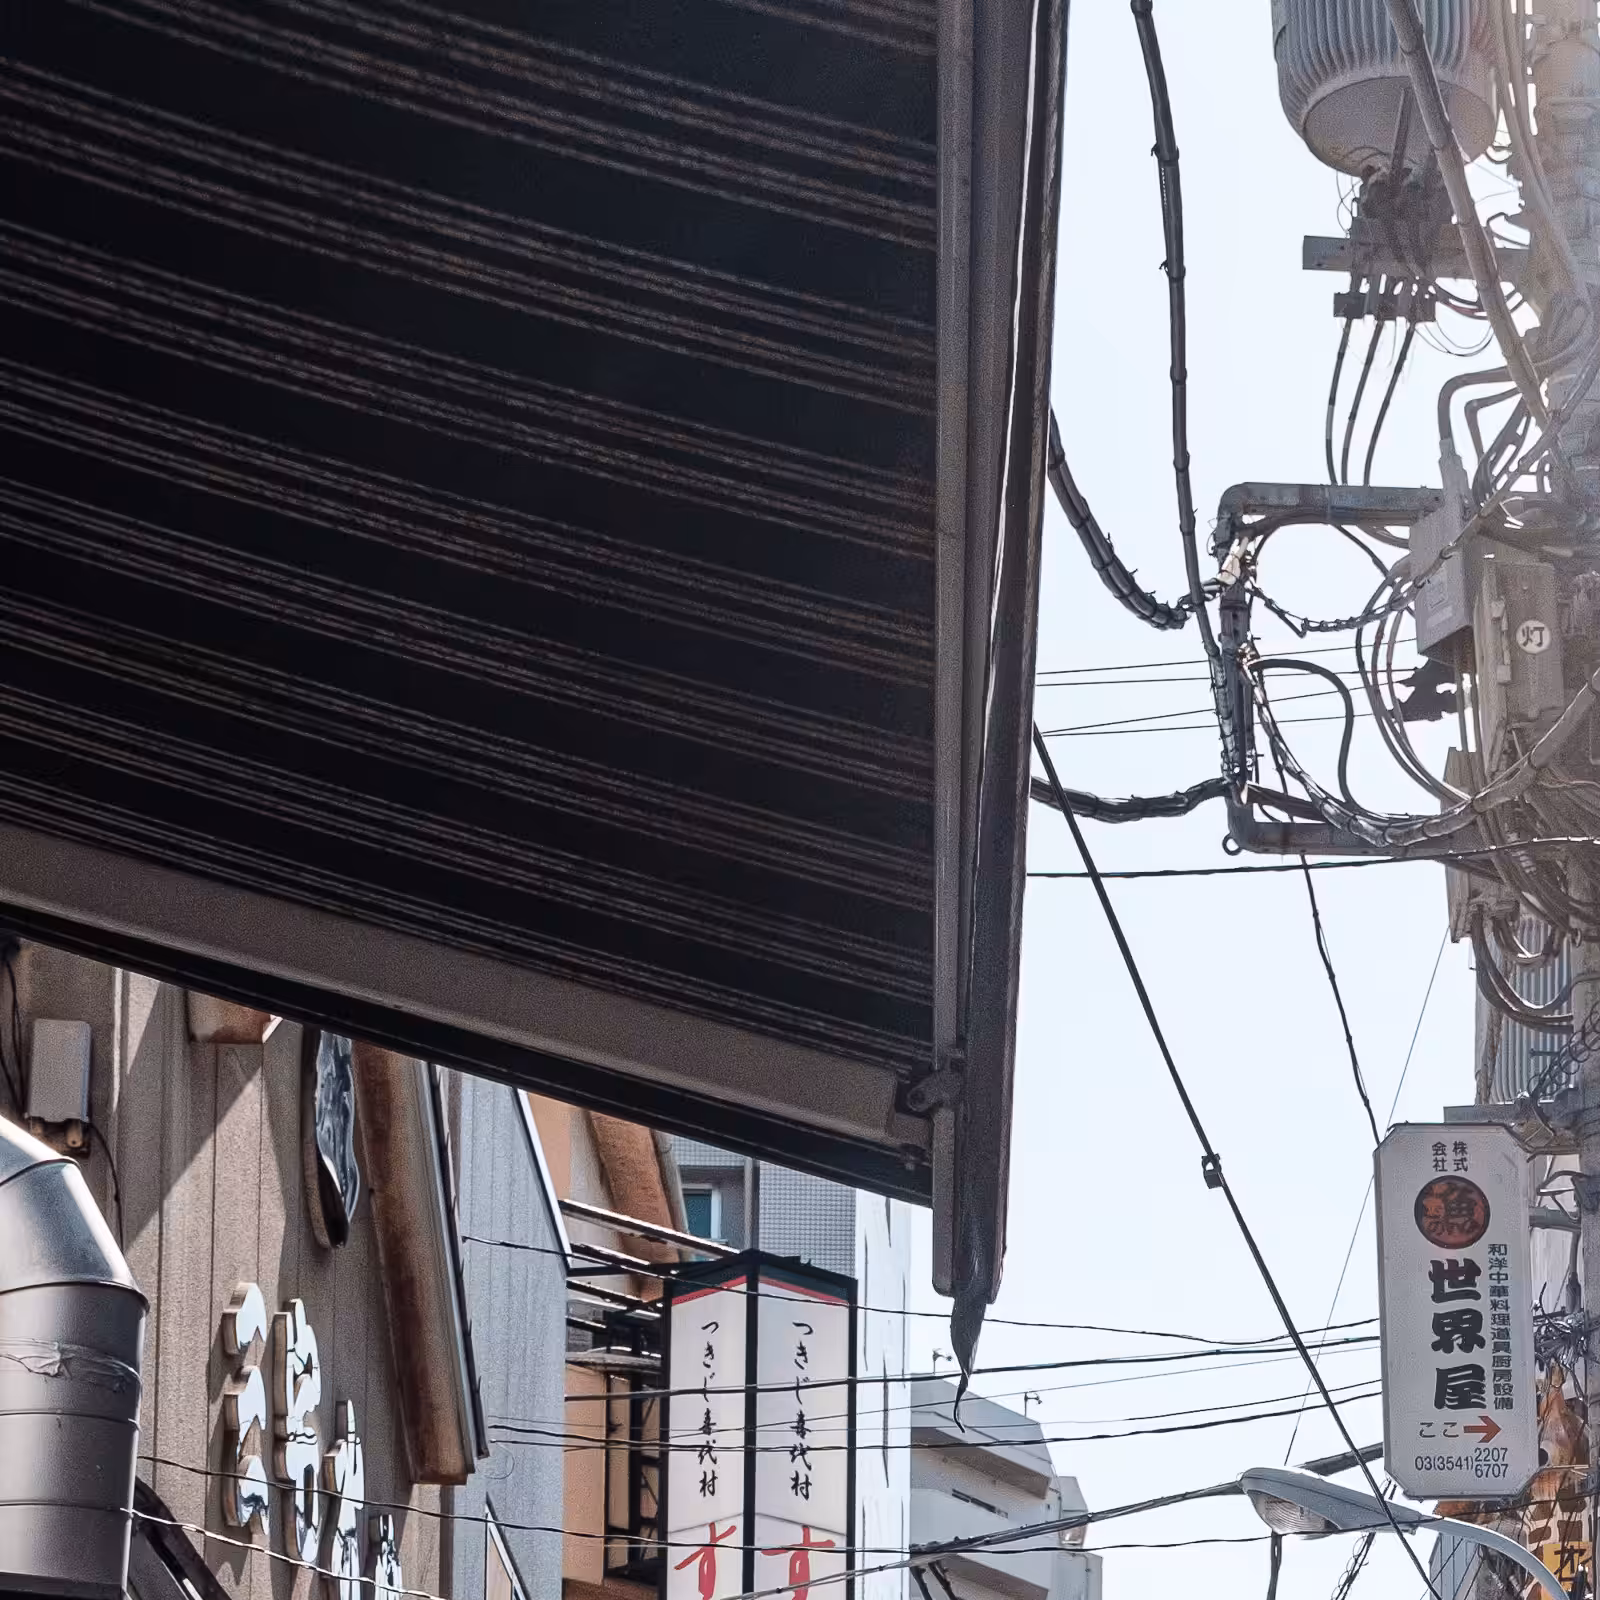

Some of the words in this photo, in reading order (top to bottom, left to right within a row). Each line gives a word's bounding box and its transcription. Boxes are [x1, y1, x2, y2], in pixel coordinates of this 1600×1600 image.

[1521, 625, 1545, 647] 灯
[1430, 1258, 1487, 1411] 世界屋
[1488, 1243, 1513, 1410] 和洋中華料理道具厨房設備
[1418, 1421, 1460, 1440] ここ
[1474, 1447, 1508, 1463] 2207
[1474, 1463, 1508, 1479] 6707
